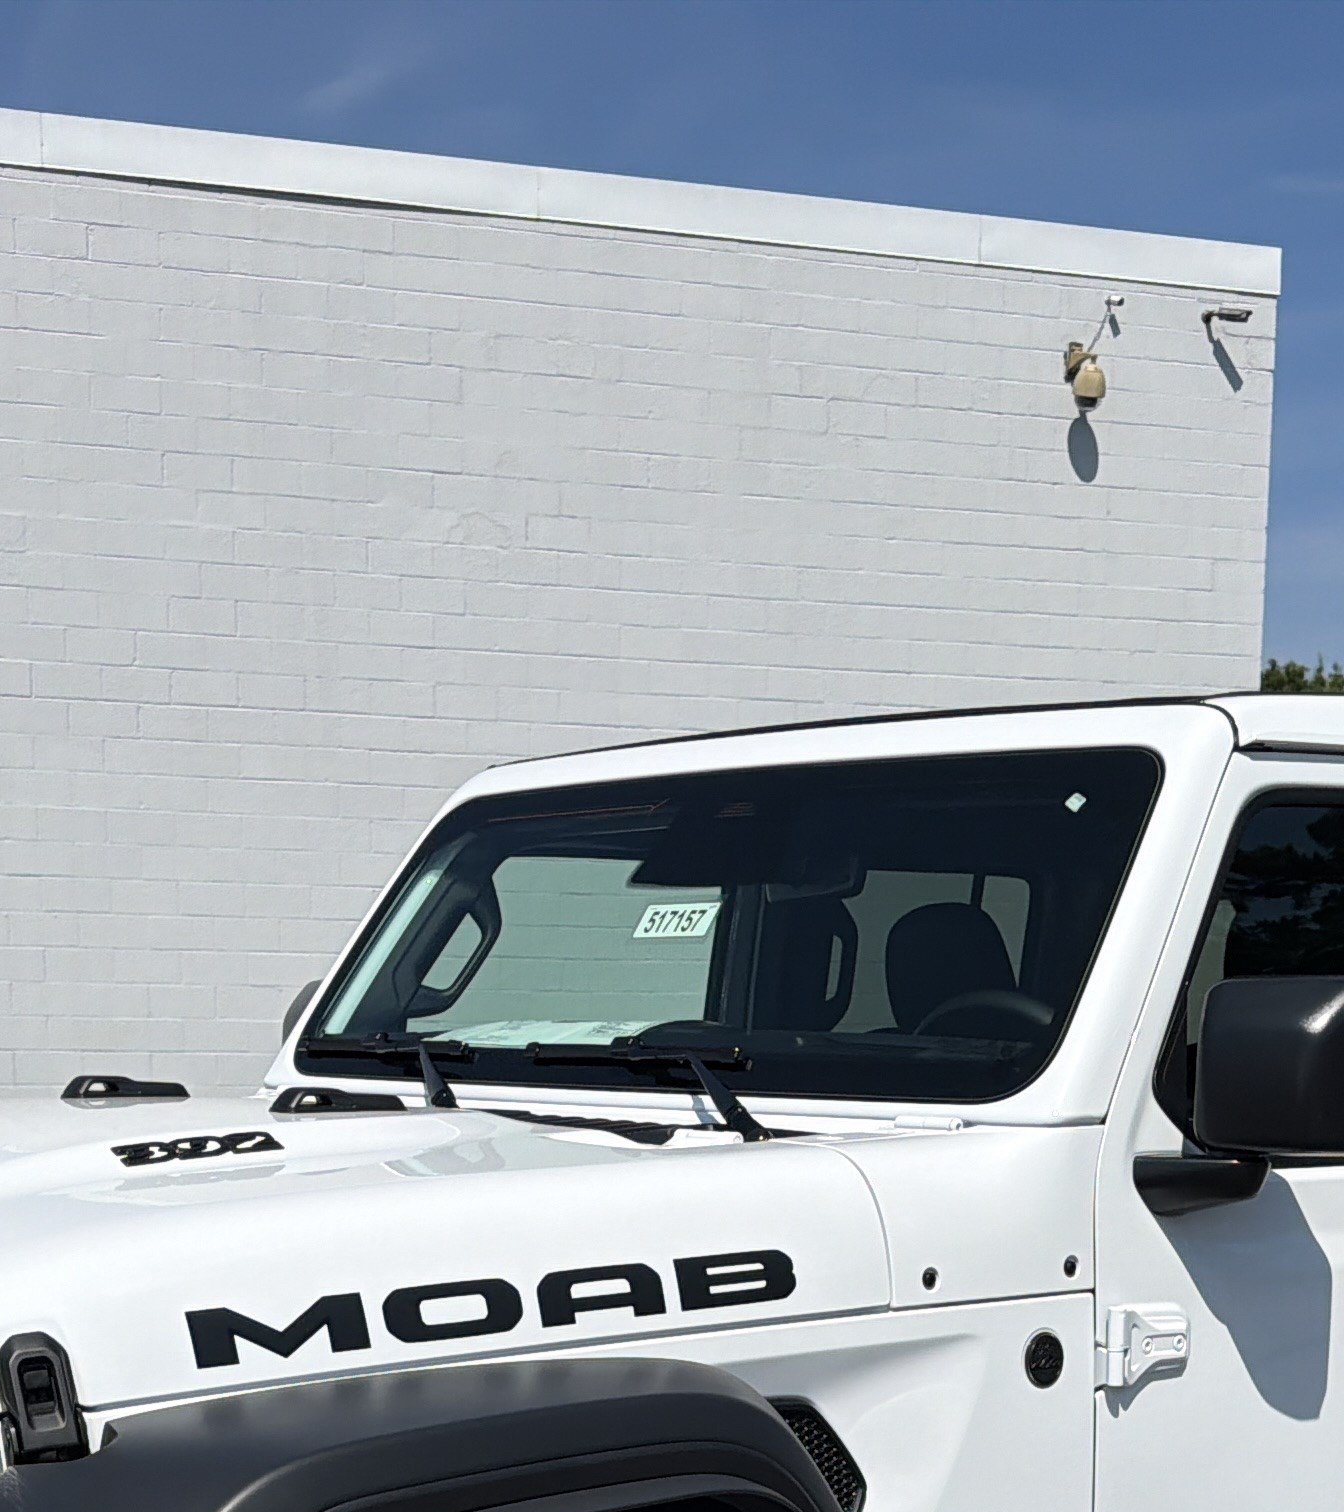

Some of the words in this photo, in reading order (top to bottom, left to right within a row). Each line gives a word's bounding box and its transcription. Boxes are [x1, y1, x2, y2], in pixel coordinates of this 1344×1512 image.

[644, 909, 708, 933] 517157
[111, 1131, 284, 1167] 392
[185, 1250, 797, 1369] MOAB
